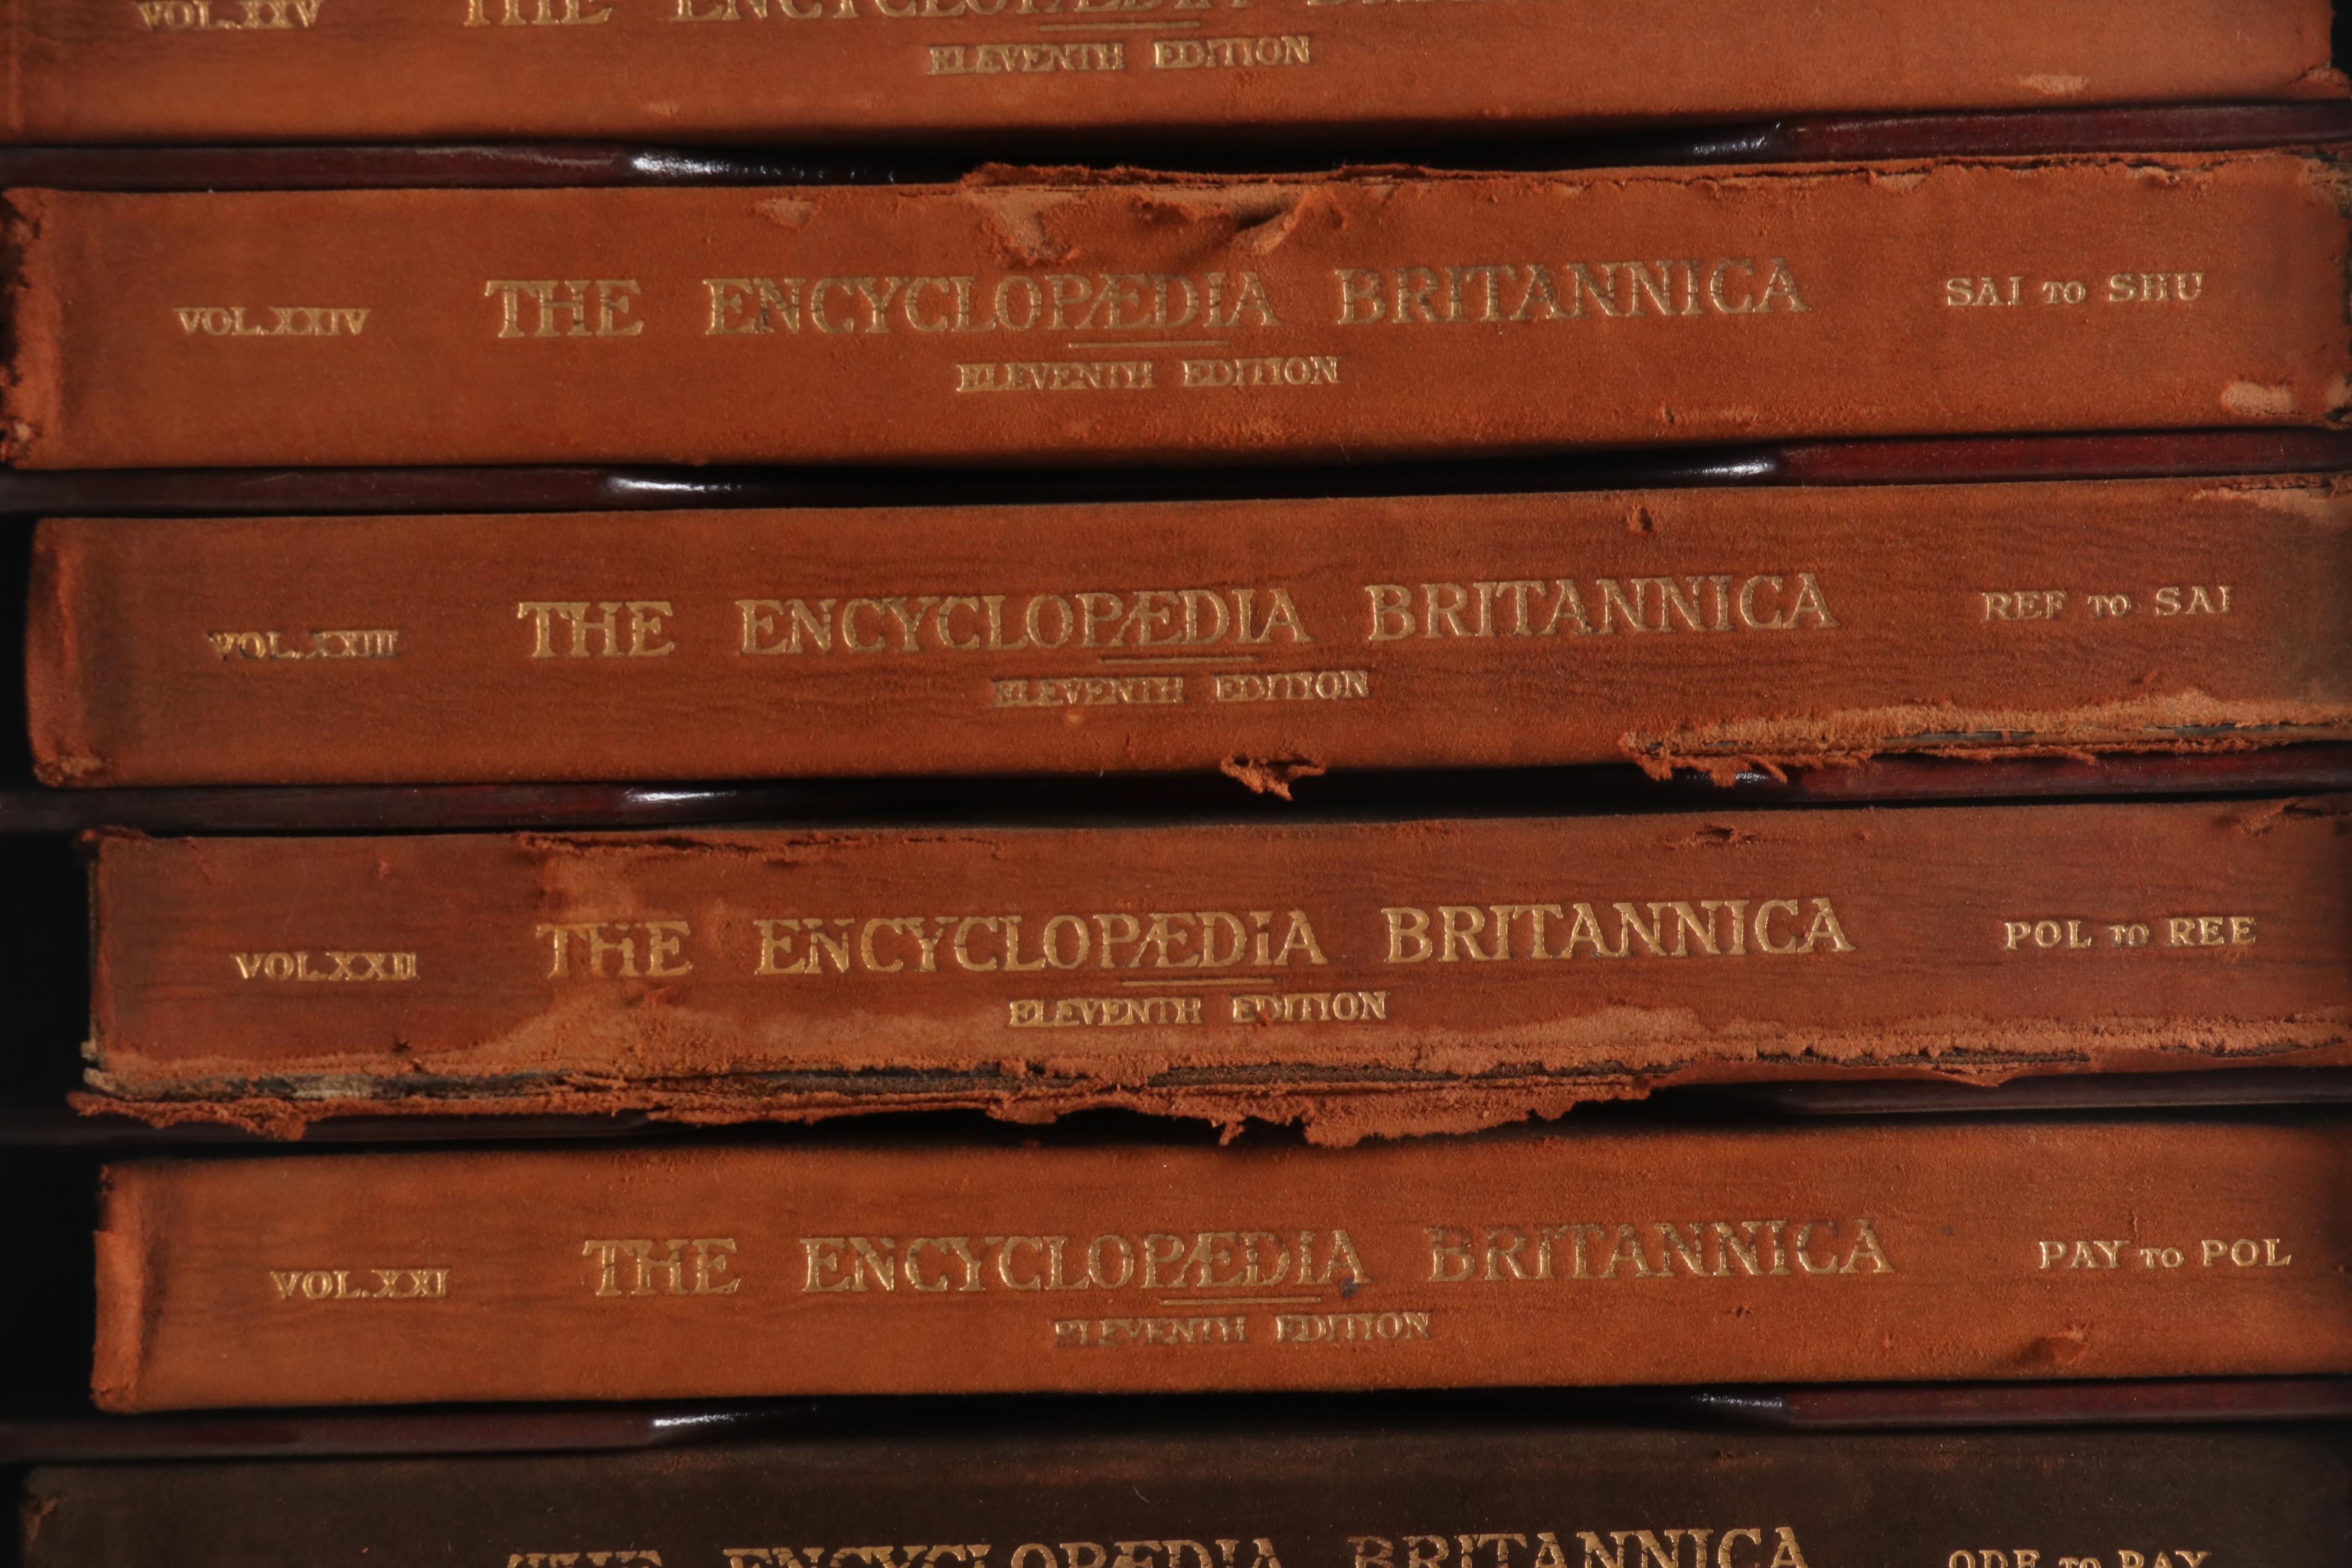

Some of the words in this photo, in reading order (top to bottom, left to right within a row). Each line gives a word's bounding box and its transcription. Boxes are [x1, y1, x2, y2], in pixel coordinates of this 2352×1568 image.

[926, 43, 1125, 75] ELEVENTH
[1153, 36, 1311, 69] EDITION
[484, 279, 645, 338] THE
[703, 272, 1284, 335] ENCYCLOPÆDIA
[1334, 257, 1812, 325] BRITANNICA
[1946, 276, 2024, 306] SAI
[2109, 272, 2206, 302] SHU
[956, 361, 1157, 393] ELEVENTH
[1181, 355, 1341, 388] EDITION
[518, 601, 675, 658] THE
[735, 588, 1314, 655] ENCYCLOPÆDIA
[1364, 572, 1841, 641] BRITANNICA
[1982, 590, 2066, 621] REF
[2155, 585, 2234, 617] SAI
[993, 676, 1186, 707] ELEVENTH
[1214, 669, 1371, 702] EDITION
[536, 921, 693, 979] THE
[753, 909, 1329, 976] ENCYCLOPÆDIA
[1381, 897, 1856, 963] BRITANNICA
[2004, 919, 2092, 950] POL
[2168, 916, 2258, 946] REE
[1007, 995, 1204, 1028] ELEVENTH
[1230, 990, 1391, 1024] EDITION
[583, 1238, 742, 1297] THE
[798, 1230, 1374, 1293] ENCYCLOPÆDIA
[1424, 1218, 1896, 1282] BRITANNICA
[2039, 1240, 2131, 1270] PAY
[2201, 1238, 2292, 1268] POL
[1053, 1315, 1247, 1347] ELEVENTH
[1273, 1311, 1432, 1344] EDITION
